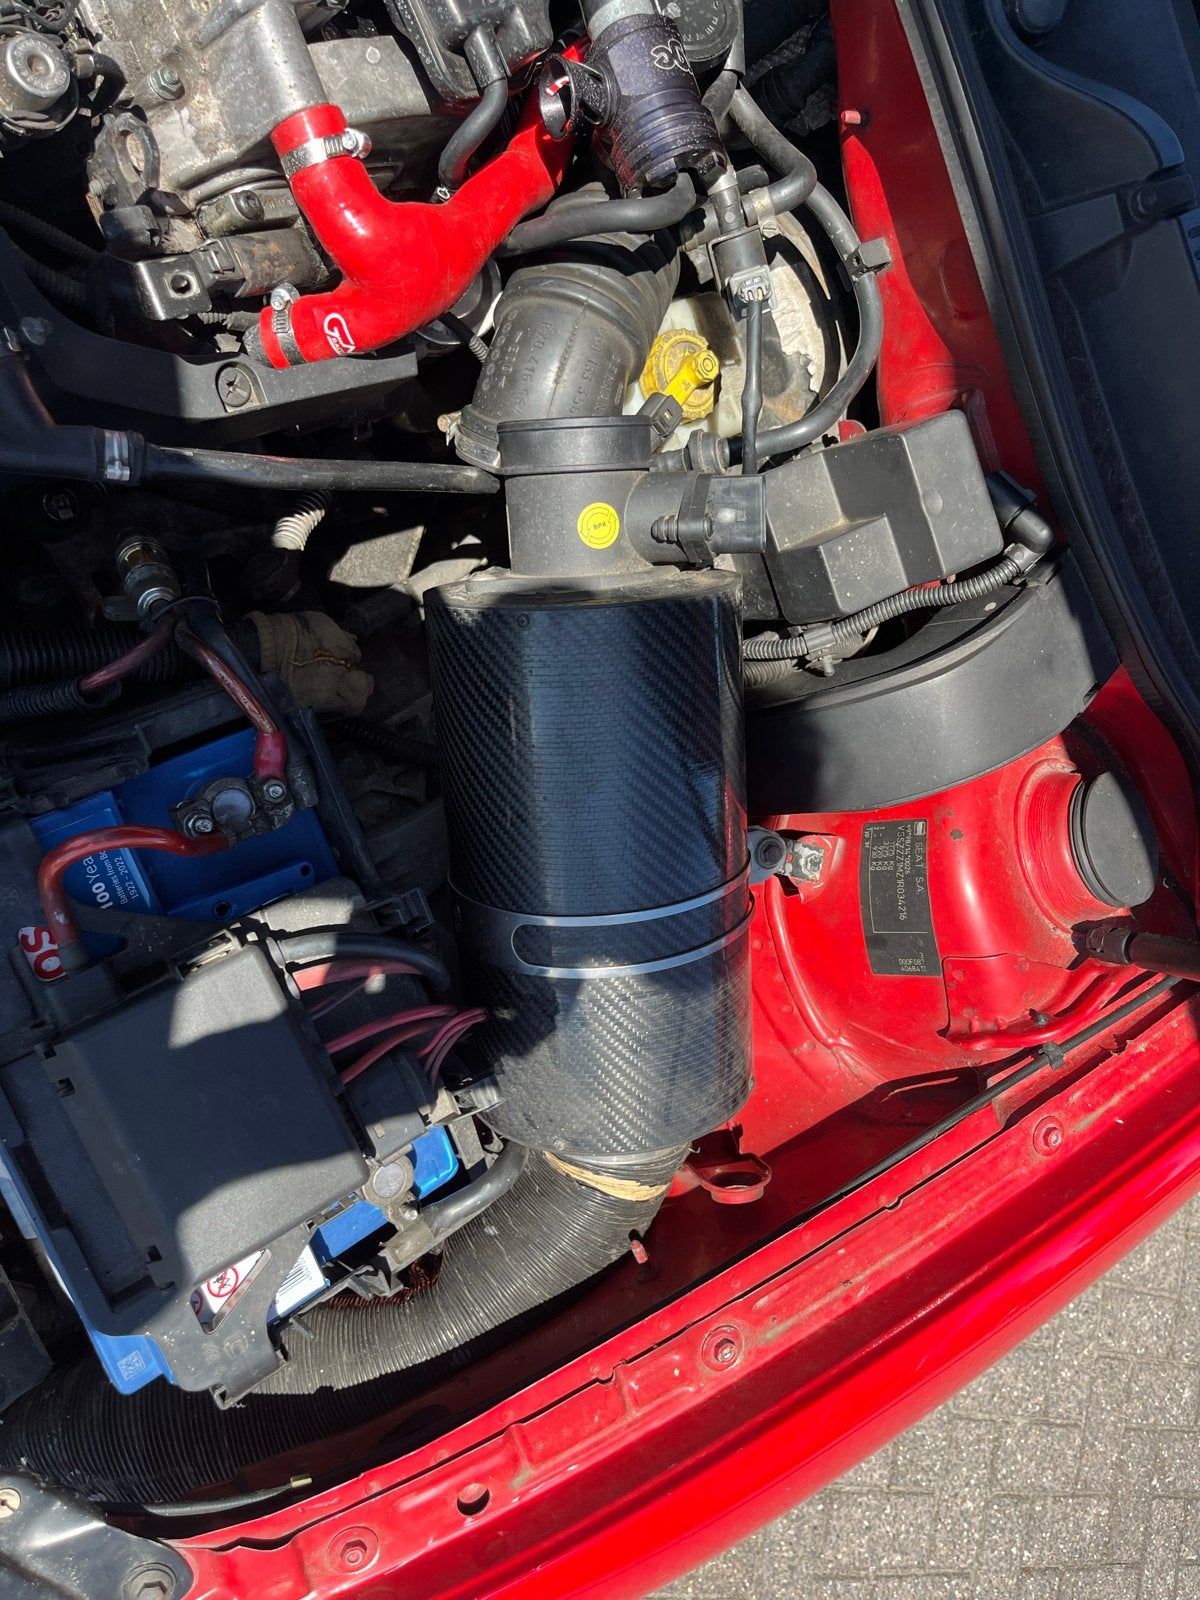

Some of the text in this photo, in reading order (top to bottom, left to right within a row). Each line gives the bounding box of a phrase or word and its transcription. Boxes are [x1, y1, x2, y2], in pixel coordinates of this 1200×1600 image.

[103, 859, 116, 876] from
[114, 856, 129, 876] 2022
[870, 861, 877, 871] Kg
[875, 861, 882, 871] Kg
[881, 860, 889, 871] Kg
[887, 860, 895, 871] Kg
[914, 842, 925, 894] SEAT S.A.
[83, 855, 114, 909] 100 Yea
[110, 874, 129, 904] Batteries
[125, 880, 139, 899] 1922
